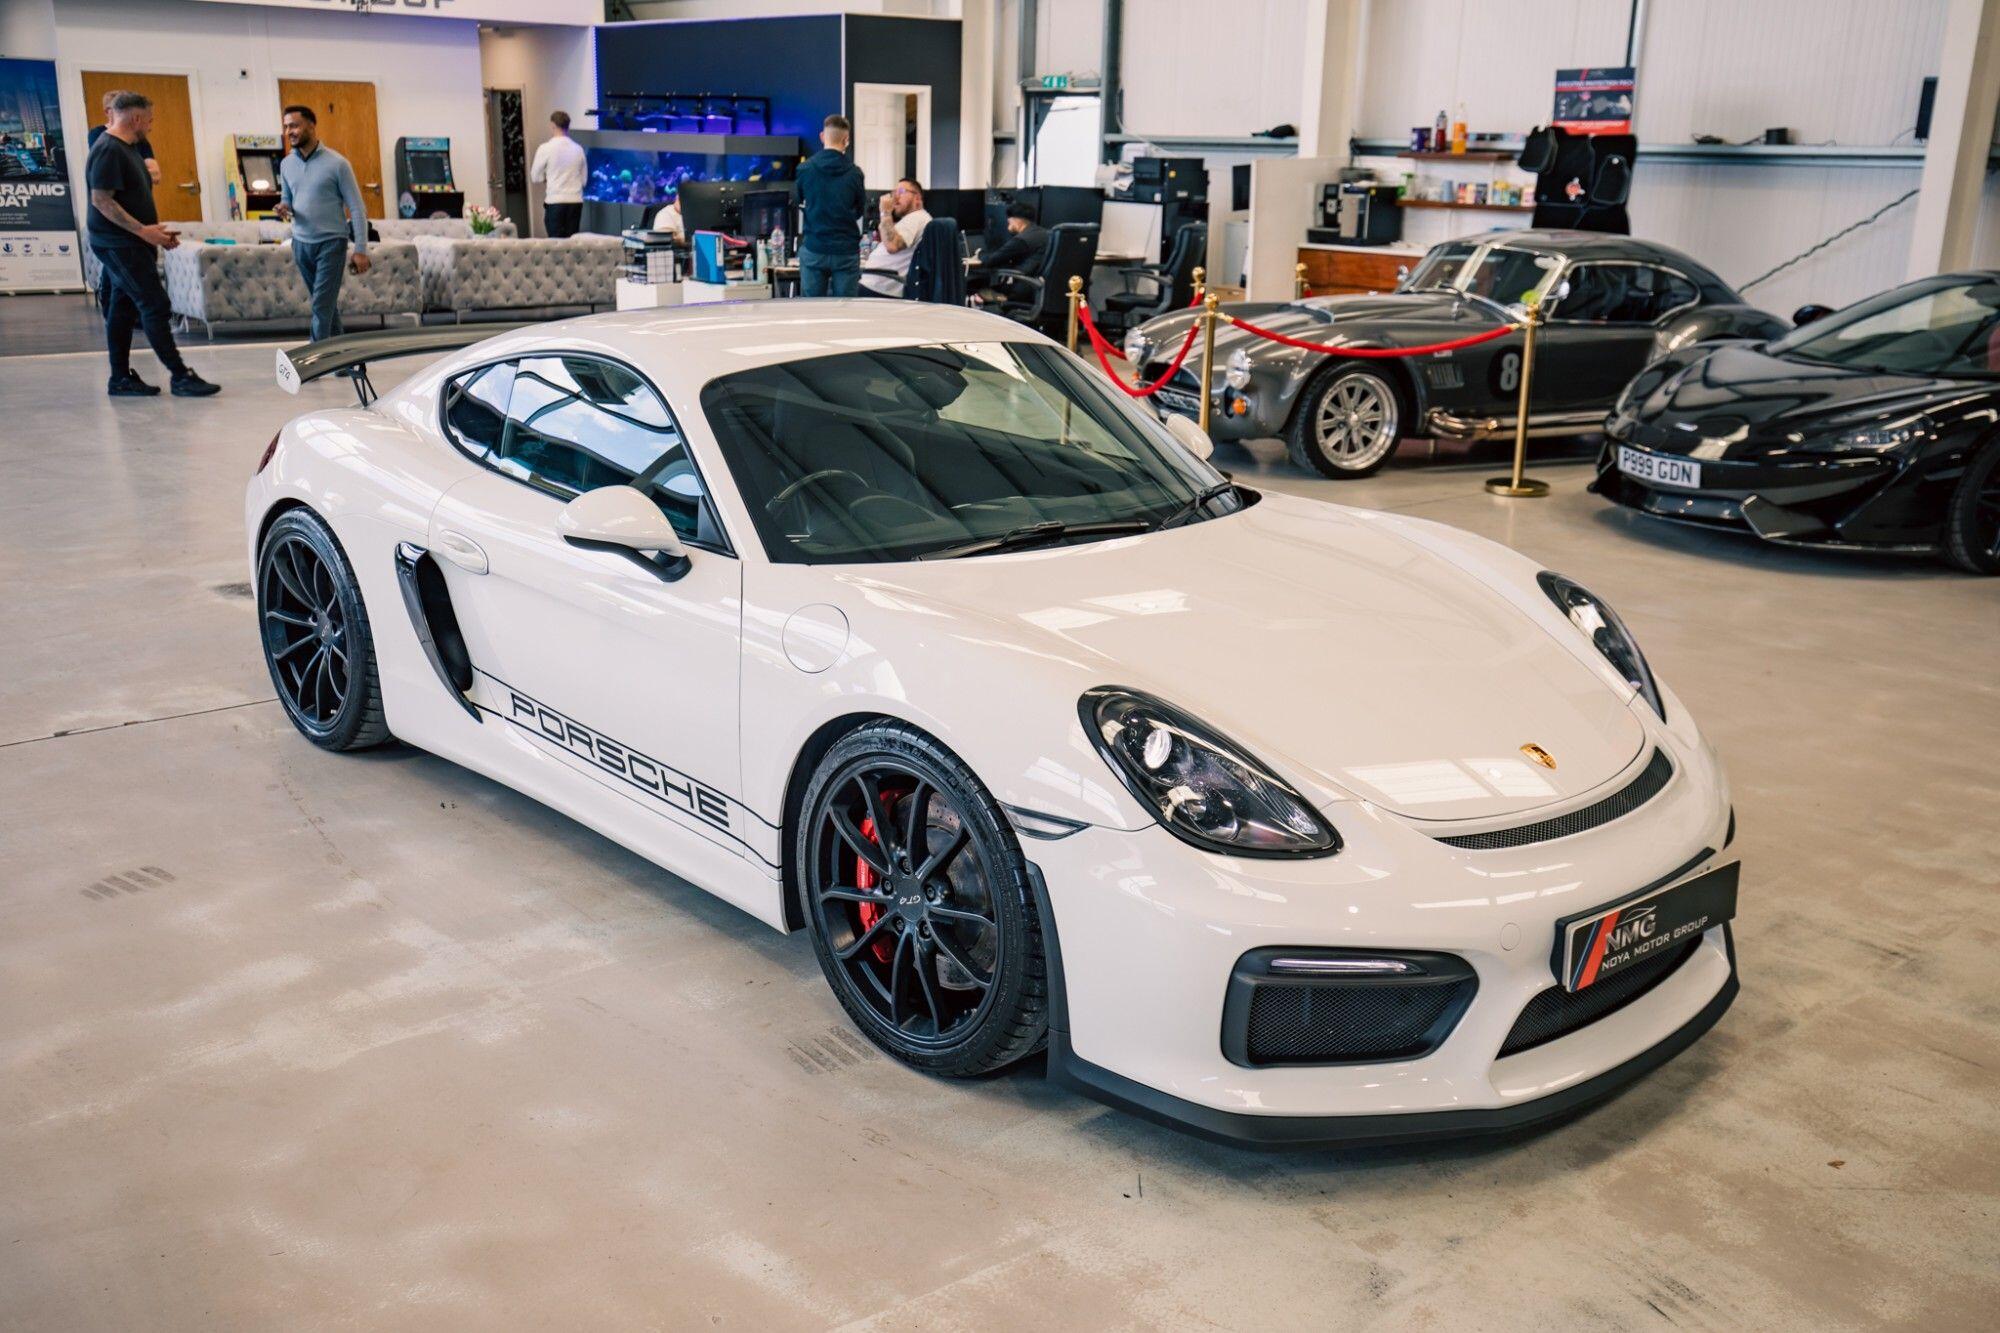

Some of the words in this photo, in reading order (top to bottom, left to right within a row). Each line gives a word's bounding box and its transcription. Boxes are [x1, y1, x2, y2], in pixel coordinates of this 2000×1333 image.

[0, 183, 66, 196] RAMIC
[1500, 352, 1520, 392] 8
[1623, 450, 1653, 476] P999
[1658, 461, 1692, 483] GDN
[510, 692, 730, 828] PORSCHE
[1601, 953, 1630, 971] NOYA
[1634, 934, 1670, 955] MOTOR
[1673, 915, 1708, 937] GROUP
[1605, 913, 1657, 955] NMG
